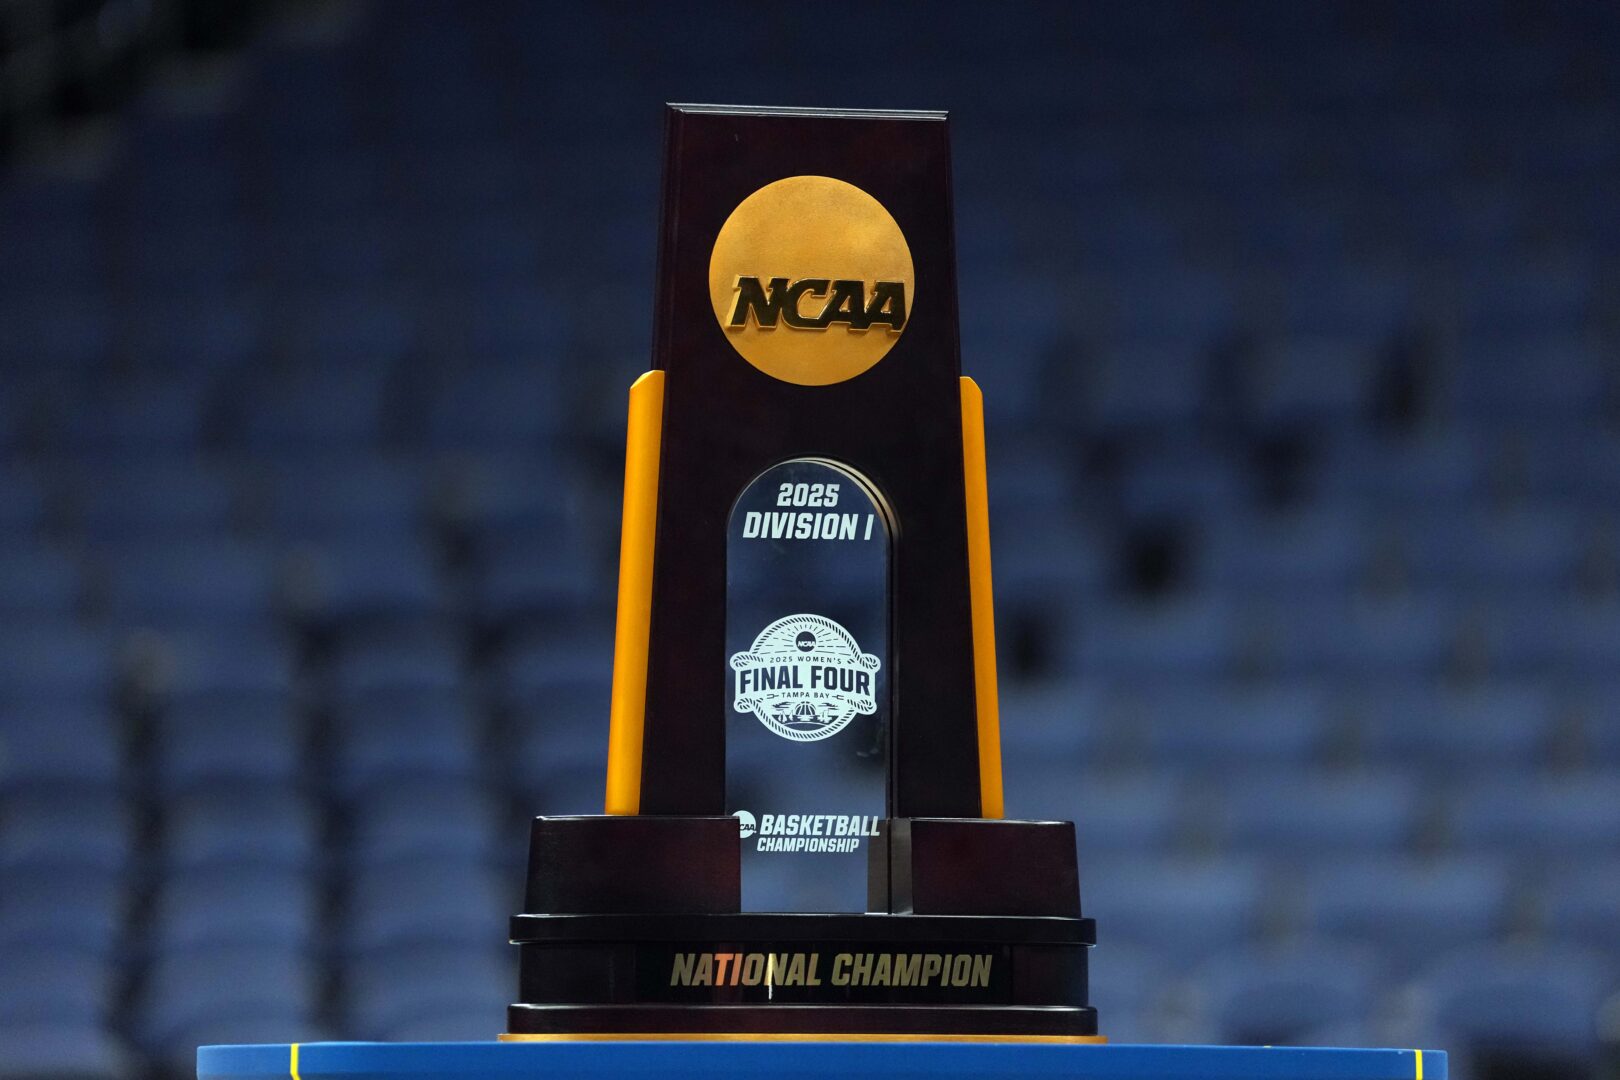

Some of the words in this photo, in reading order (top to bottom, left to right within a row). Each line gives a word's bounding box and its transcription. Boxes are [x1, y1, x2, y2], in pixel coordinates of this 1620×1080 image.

[728, 274, 906, 332] NCAA
[776, 483, 840, 507] 2025
[742, 512, 858, 540] DIVISION
[864, 514, 874, 540] I
[797, 640, 816, 648] NCAA
[797, 656, 842, 665] WOMEN'S
[740, 665, 803, 694] FINAL
[811, 665, 870, 696] FOUR
[760, 814, 880, 836] BASKETBALL
[757, 837, 860, 853] CHAMPIONSHIP
[670, 953, 821, 986] NATIONAL
[830, 953, 993, 987] CHAMPION
